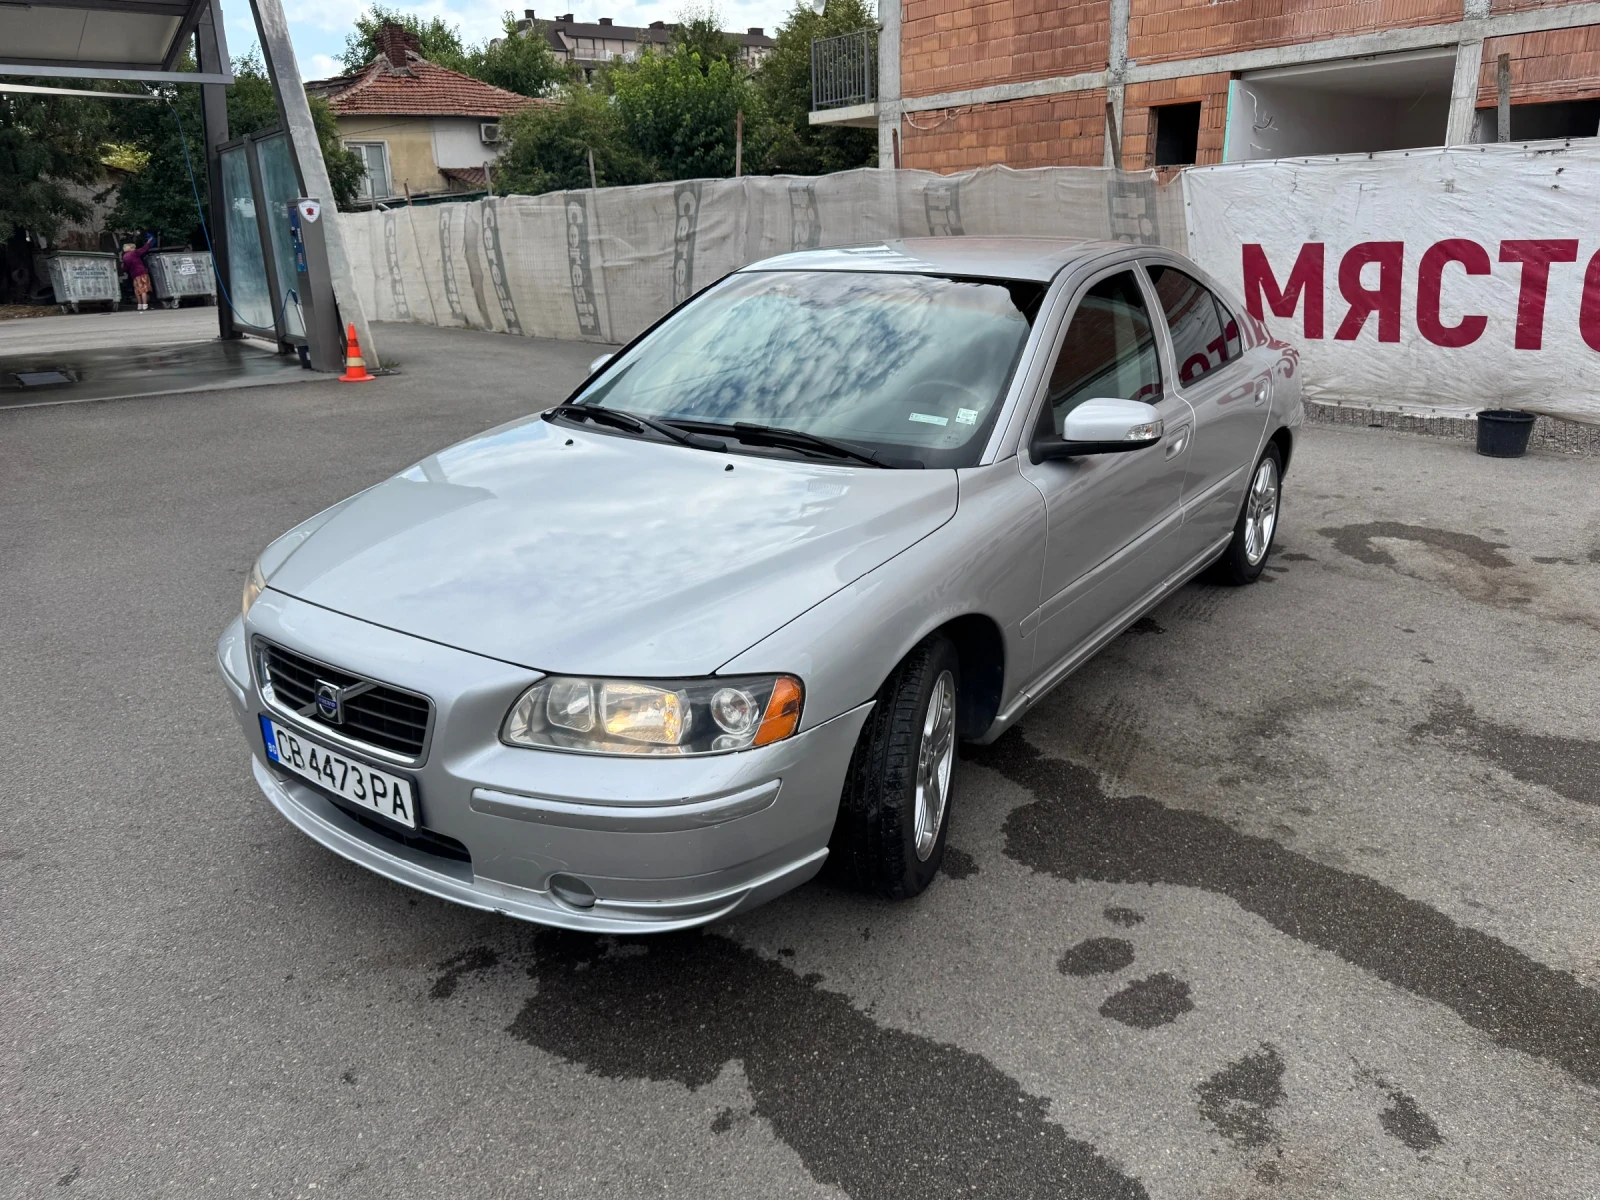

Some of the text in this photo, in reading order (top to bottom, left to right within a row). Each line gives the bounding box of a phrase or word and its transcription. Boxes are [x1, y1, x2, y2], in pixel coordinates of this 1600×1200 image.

[483, 206, 516, 323] Ceresit
[567, 201, 595, 329] Ceresit
[675, 191, 696, 304] Ceres
[1242, 238, 1600, 352] МЯСТ
[267, 741, 277, 755] BG
[309, 747, 367, 801] 4473
